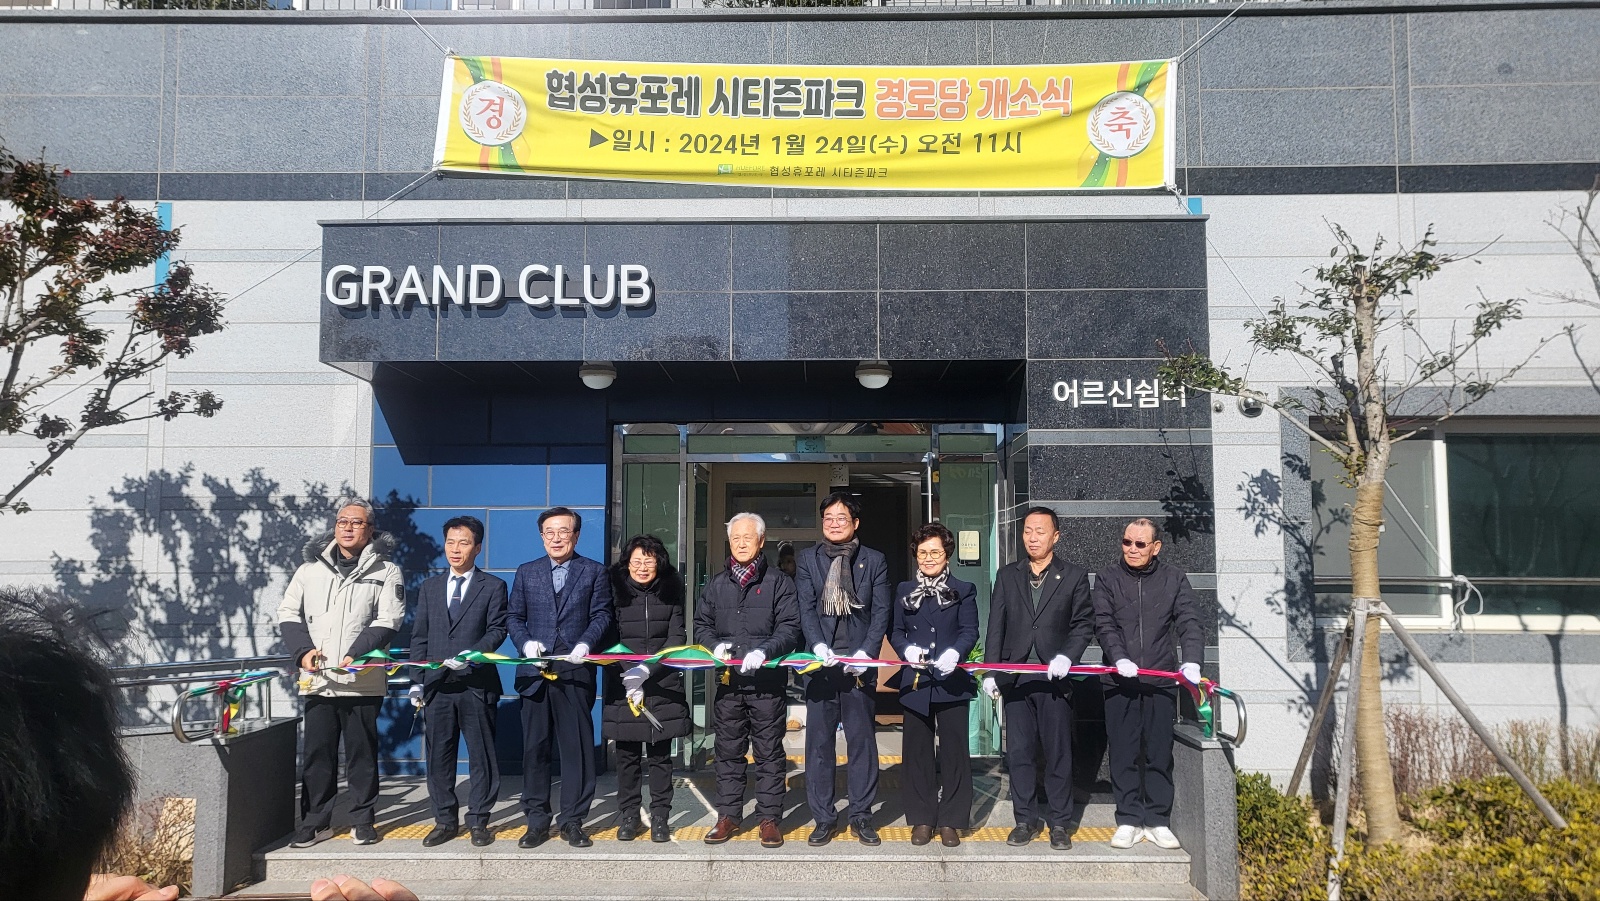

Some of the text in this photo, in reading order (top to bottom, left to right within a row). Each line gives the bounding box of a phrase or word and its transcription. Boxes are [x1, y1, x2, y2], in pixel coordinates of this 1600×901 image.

[545, 69, 1072, 119] 협성휴포레 시티즌파크 경로당 개소식
[475, 95, 504, 130] 경
[1103, 106, 1138, 139] 축
[612, 129, 655, 152] 일시
[679, 133, 760, 156] 2024년
[771, 133, 806, 156] 1월
[815, 133, 908, 155] 24일(수)
[917, 133, 962, 155] 오전
[973, 131, 1022, 154] 11시
[769, 165, 888, 179] 협성휴포레 시티즌파크
[325, 264, 652, 306] GRAND CLUB
